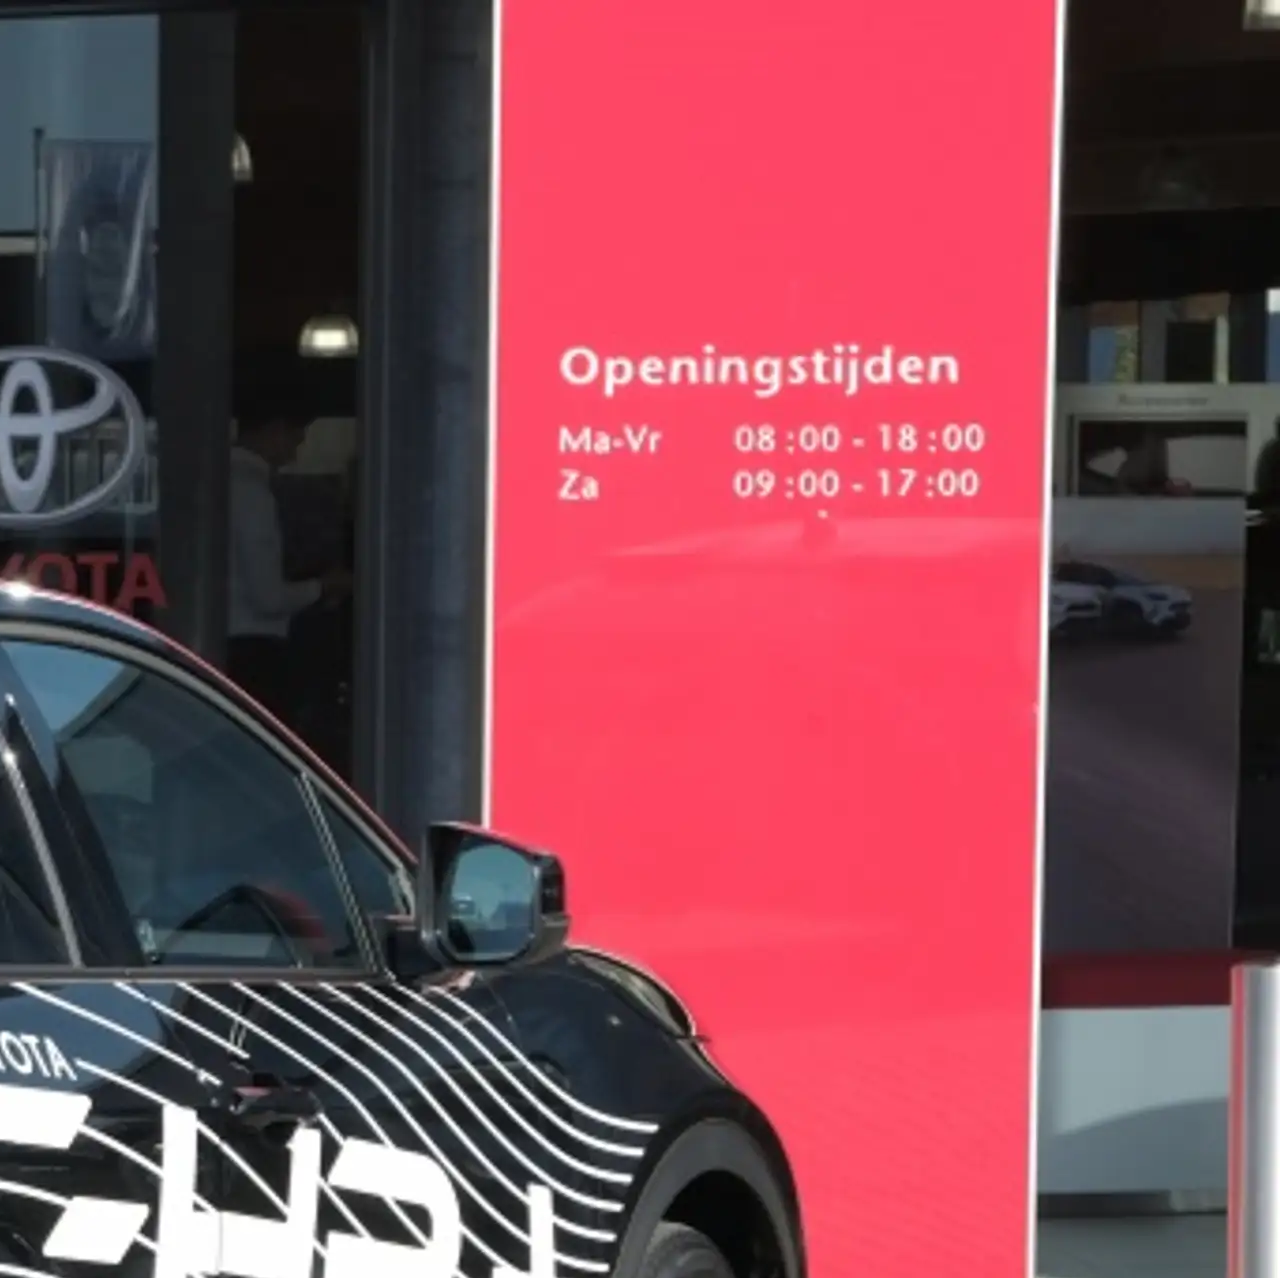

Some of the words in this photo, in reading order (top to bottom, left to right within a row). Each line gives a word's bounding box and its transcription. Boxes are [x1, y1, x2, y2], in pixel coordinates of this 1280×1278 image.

[559, 344, 960, 398] Openingstijden
[559, 425, 662, 454] Ma-Vr
[558, 469, 600, 500] Za
